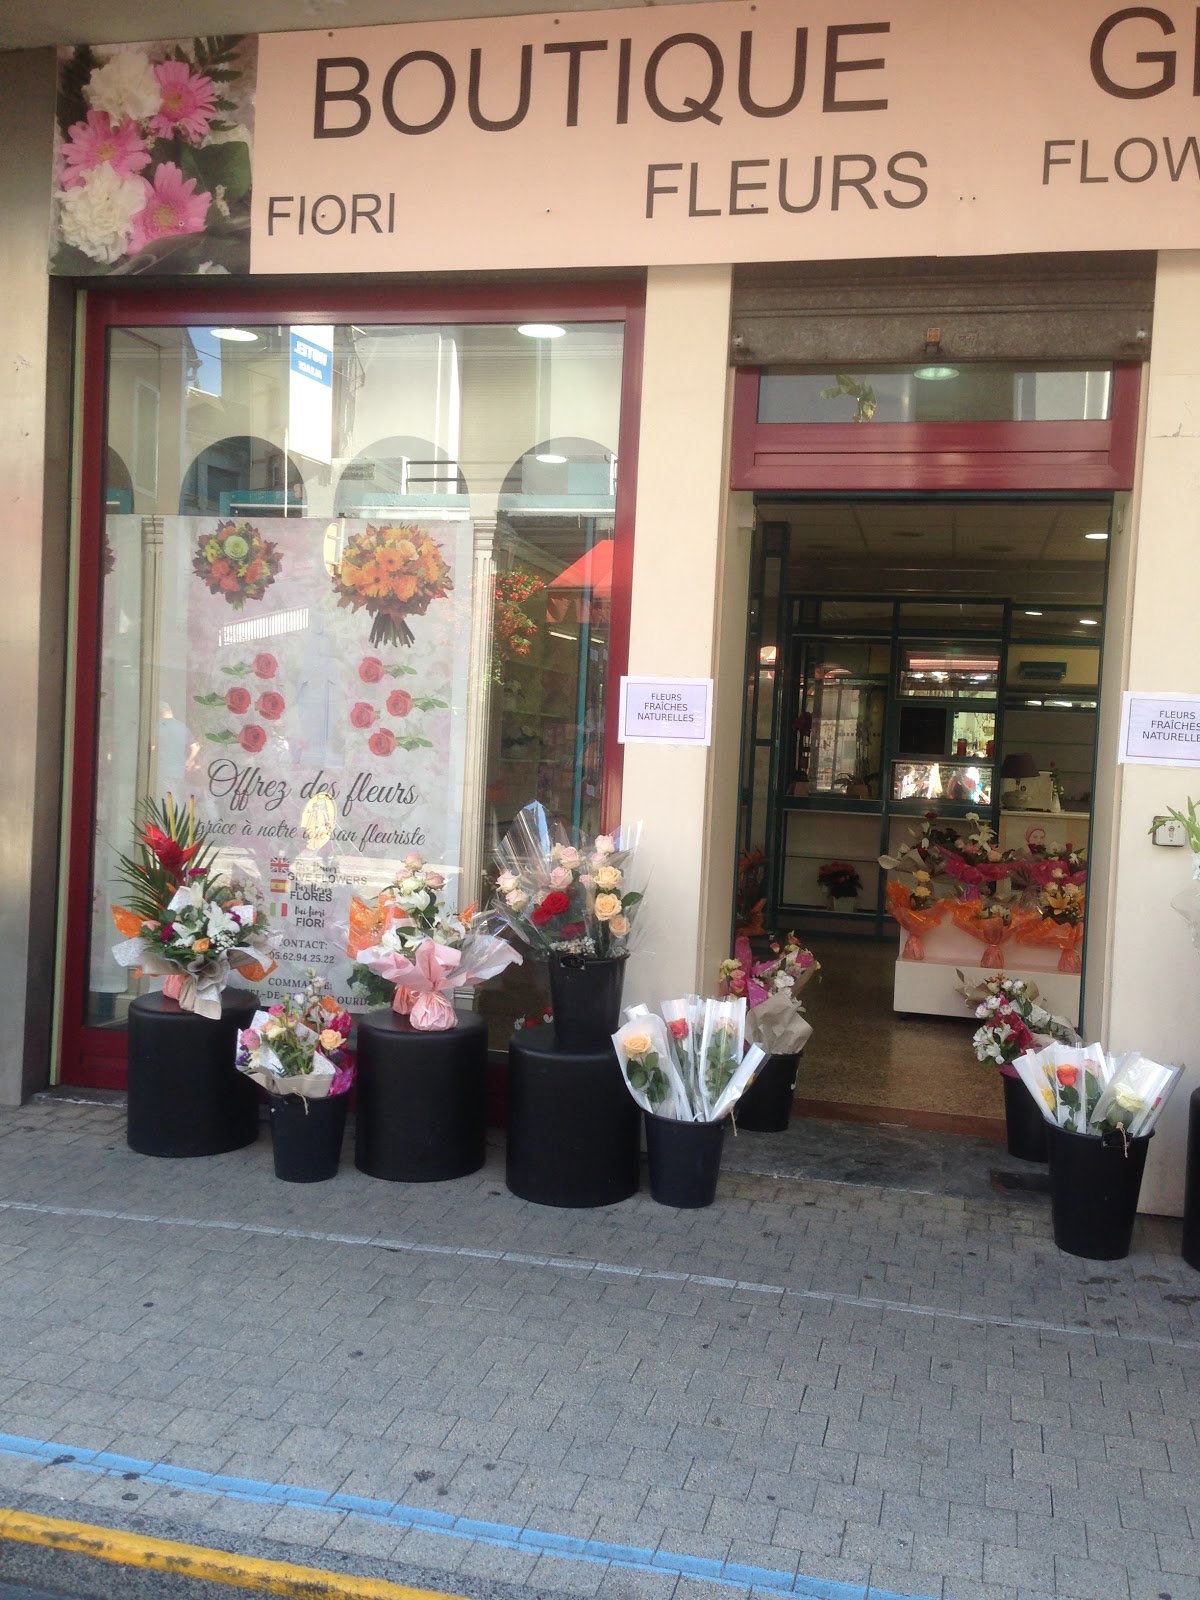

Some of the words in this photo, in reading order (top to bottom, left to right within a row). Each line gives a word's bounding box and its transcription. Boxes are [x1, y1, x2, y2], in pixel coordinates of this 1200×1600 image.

[312, 22, 890, 139] BOUTIQUE
[1090, 6, 1200, 99] G
[268, 193, 395, 236] FIORI
[646, 151, 928, 218] FLEURS
[651, 693, 682, 701] FLEURS
[644, 701, 688, 711] FRAÎCHES
[637, 712, 694, 722] NATURELLES
[1159, 710, 1196, 720] FLEURS
[208, 758, 292, 811] Offrez
[300, 770, 340, 799] des
[342, 773, 419, 816] fleurs
[241, 819, 252, 836] à
[257, 819, 298, 839] notre
[359, 824, 426, 852] fleuriste
[287, 871, 313, 882] GIVE
[315, 874, 368, 885] FLOWERS
[290, 891, 333, 902] FLORES
[296, 917, 325, 928] FIORI
[279, 938, 328, 949] ONTACT:
[268, 977, 333, 990] COMMANE:
